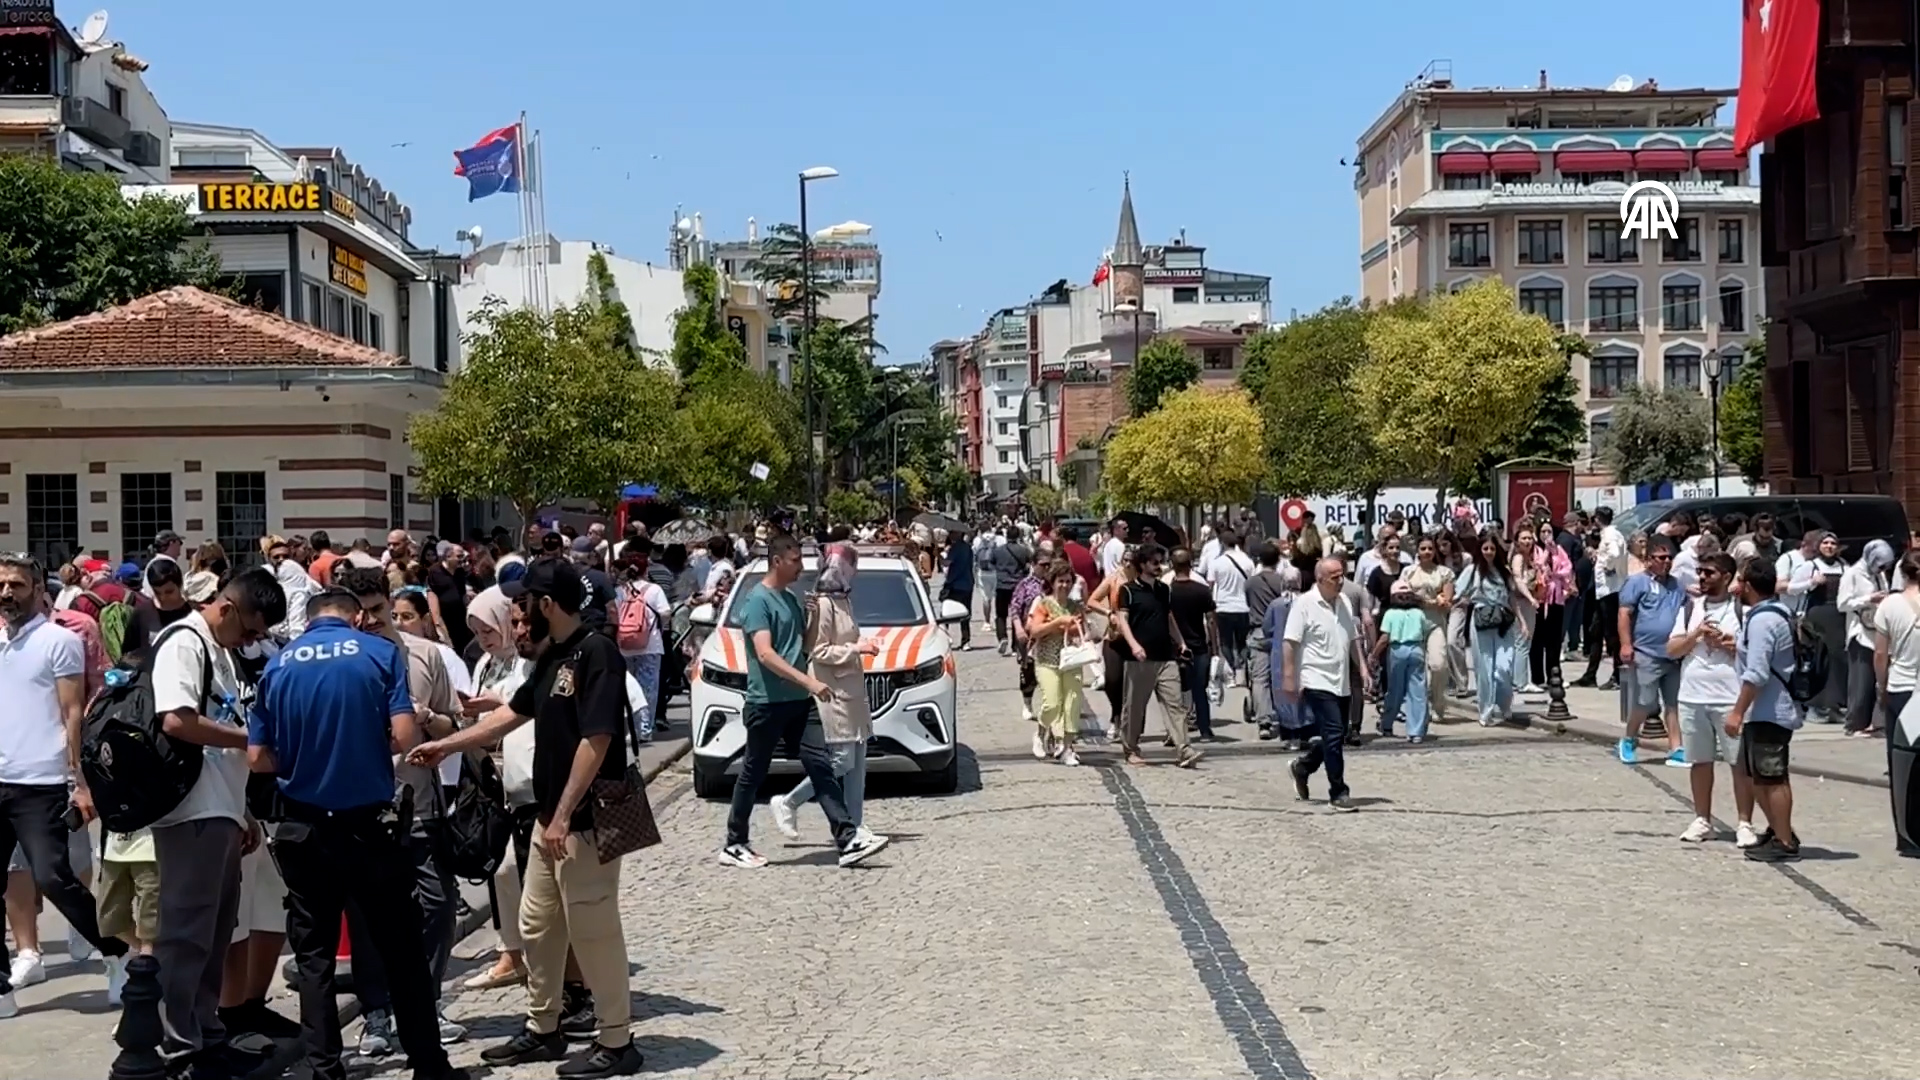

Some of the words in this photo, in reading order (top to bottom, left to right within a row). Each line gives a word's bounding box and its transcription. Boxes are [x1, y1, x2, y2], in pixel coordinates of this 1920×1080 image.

[3, 10, 52, 23] Terrace
[203, 184, 320, 210] TERRACE
[1505, 182, 1585, 195] PANORAMA
[1325, 504, 1388, 526] BELTR
